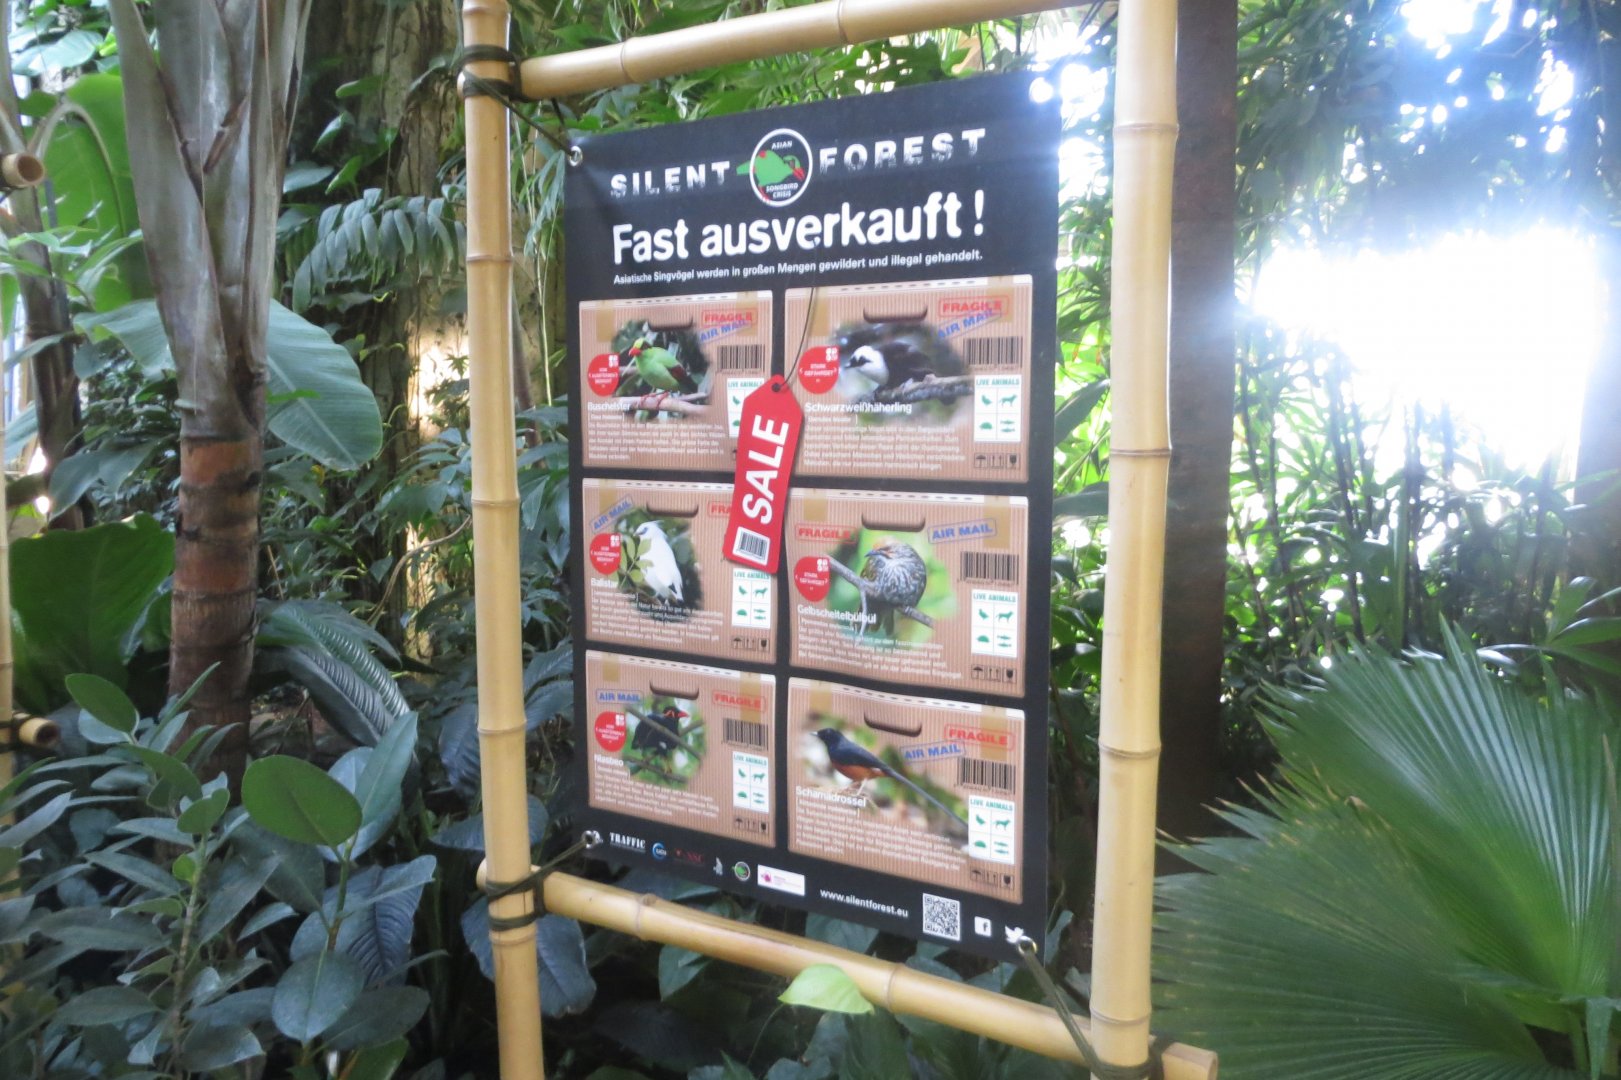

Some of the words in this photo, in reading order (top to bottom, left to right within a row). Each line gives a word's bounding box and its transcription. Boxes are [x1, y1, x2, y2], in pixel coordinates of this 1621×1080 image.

[771, 140, 793, 150] ASIAN
[819, 128, 986, 173] FOREST
[610, 161, 730, 197] SILENT
[613, 218, 690, 264] Fast
[700, 191, 963, 253] ausverkauft
[613, 274, 652, 285] Asiatische
[653, 269, 694, 283] Singvögel
[696, 267, 730, 280] werden
[732, 266, 741, 276] in
[742, 264, 775, 278] großen
[777, 261, 817, 274] Mengen
[819, 258, 866, 273] gewildert
[869, 255, 888, 267] und
[891, 253, 922, 268] illegal
[925, 249, 983, 266] gehandelt.
[700, 327, 718, 342] AIR
[937, 321, 960, 339] AIR
[991, 378, 1020, 386] ANIMALS
[742, 414, 790, 525] SALE
[592, 513, 610, 531] AIR
[609, 500, 632, 520] MAIL
[931, 527, 956, 541] AIR
[958, 523, 993, 537] MAIL
[988, 594, 1017, 603] ANIMALS
[598, 691, 615, 701] AIR
[949, 728, 1008, 746] FRAGILE
[904, 748, 926, 760] AIR
[928, 743, 962, 757] MAIL
[970, 798, 983, 807] LIVE
[985, 800, 1013, 812] ANIMALS
[609, 832, 646, 849] TRAFFIC
[820, 889, 909, 918] www.silentforest.eu
